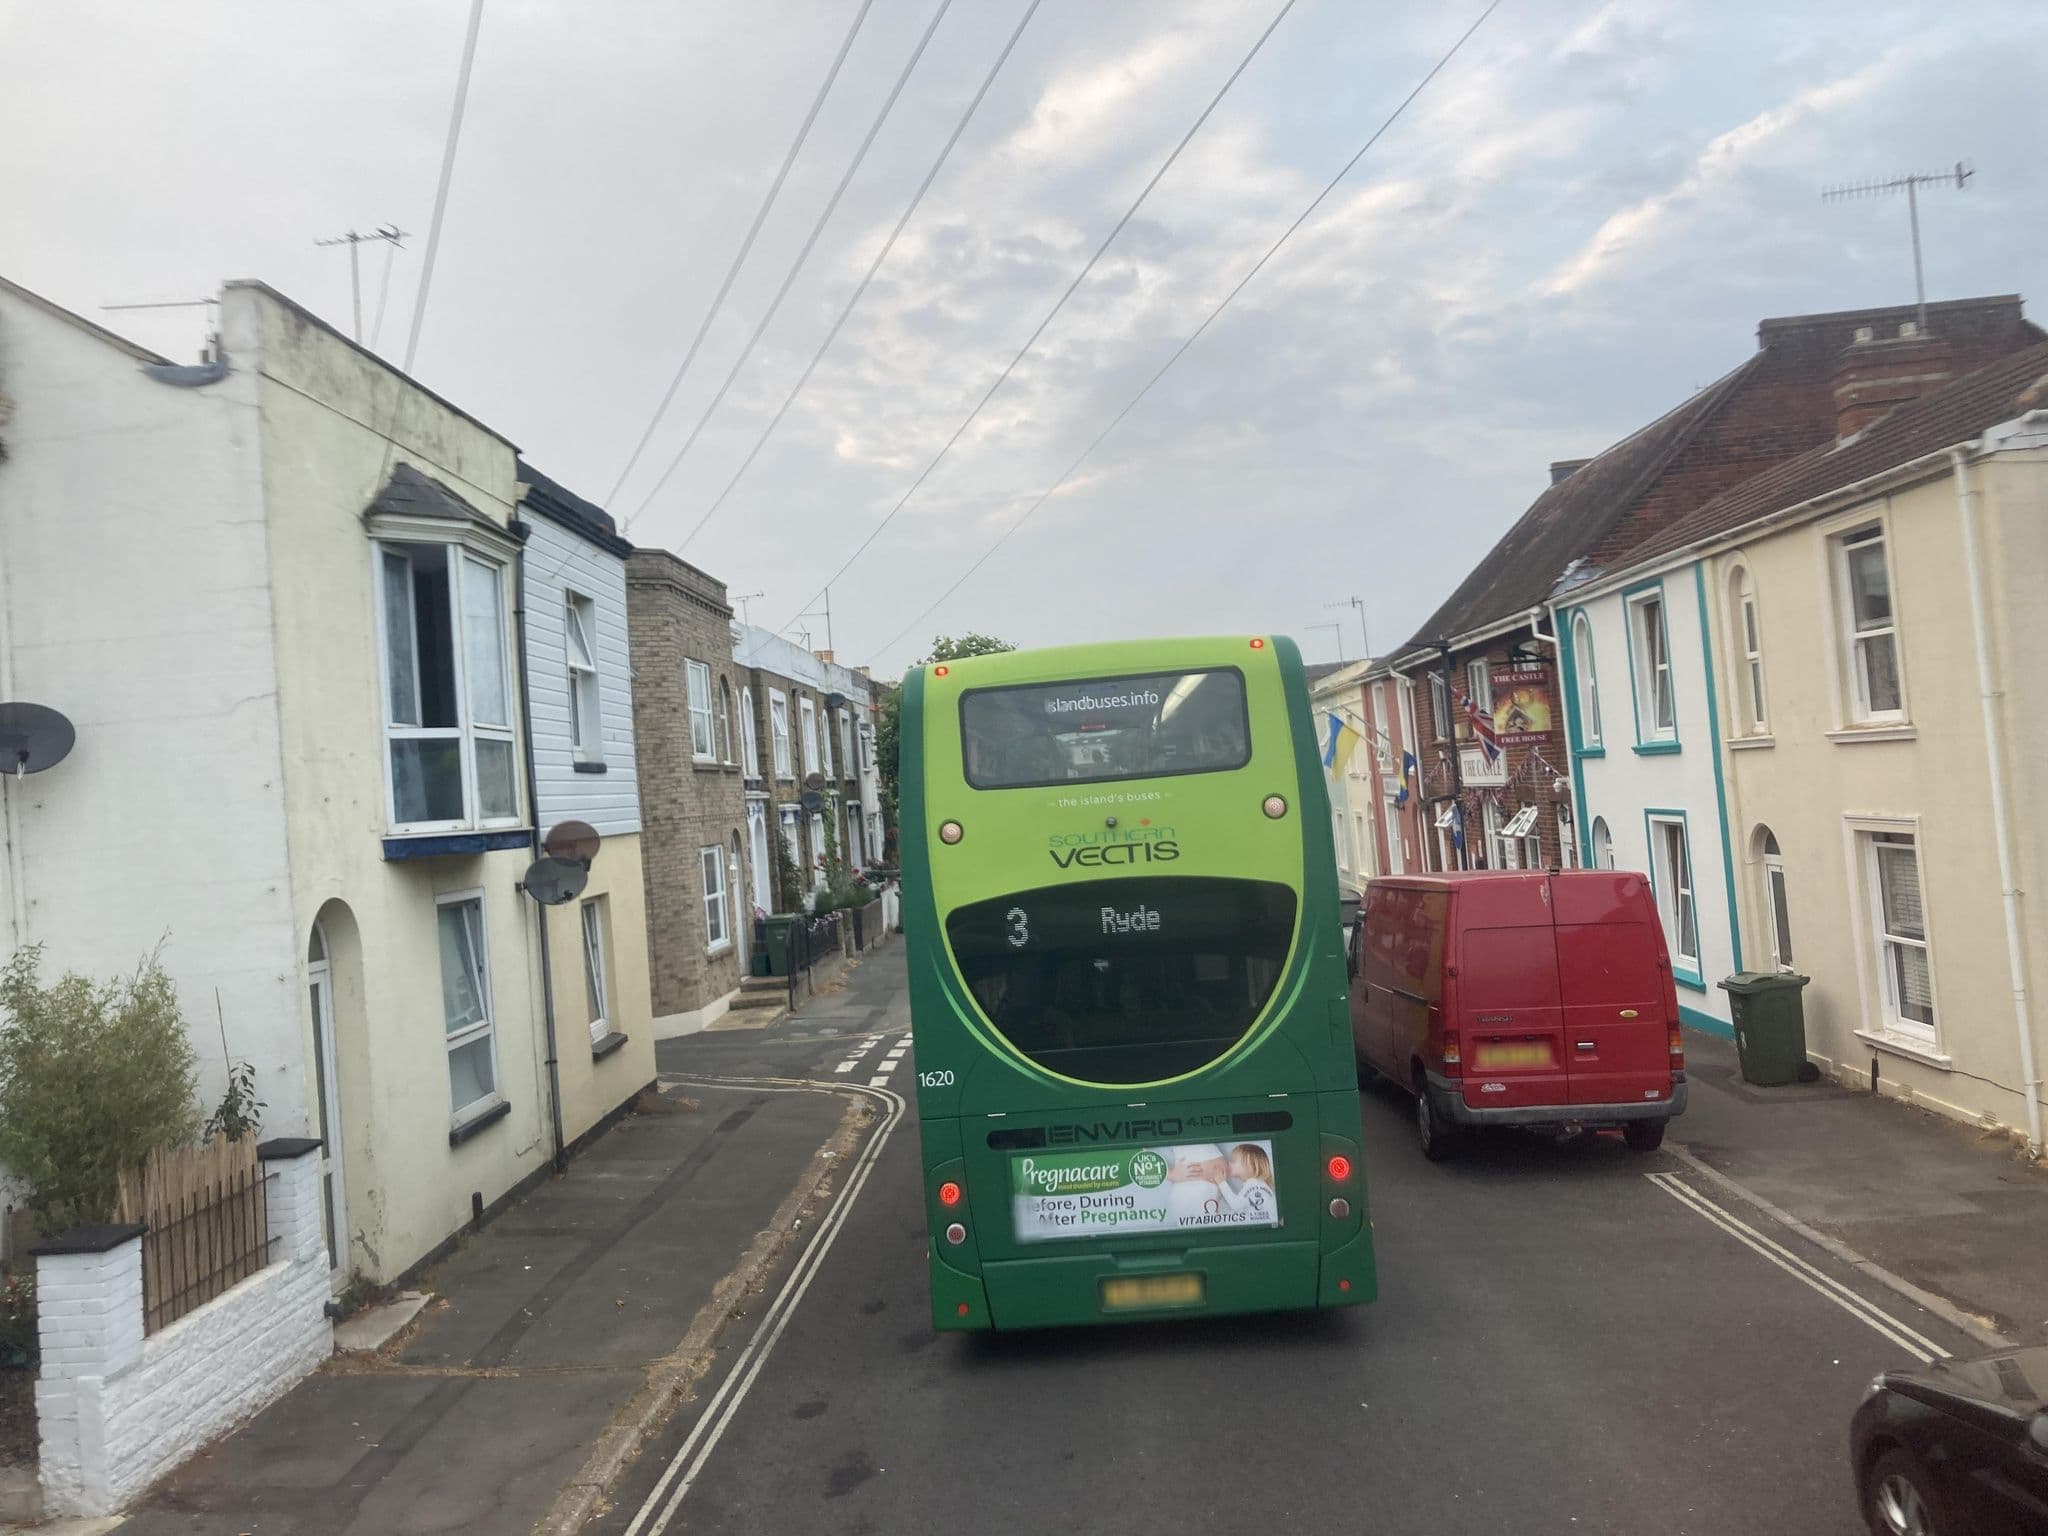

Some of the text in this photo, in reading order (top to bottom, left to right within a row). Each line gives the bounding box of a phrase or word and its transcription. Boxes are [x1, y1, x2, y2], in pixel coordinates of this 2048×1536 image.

[1493, 672, 1545, 683] THE CASTLE
[1501, 734, 1547, 744] FREE HOUSE
[1058, 791, 1161, 808] the island's buses
[1049, 840, 1180, 869] VECTIS
[1006, 904, 1161, 947] 3 Ryde
[918, 1070, 955, 1087] 1620
[1049, 1119, 1183, 1144] ENVIRO
[1022, 1158, 1120, 1193] Pregnacare
[1029, 1194, 1135, 1213] efore, During
[1081, 1208, 1167, 1226] Pregnancy
[1179, 1212, 1246, 1227] VITABIOTICS
